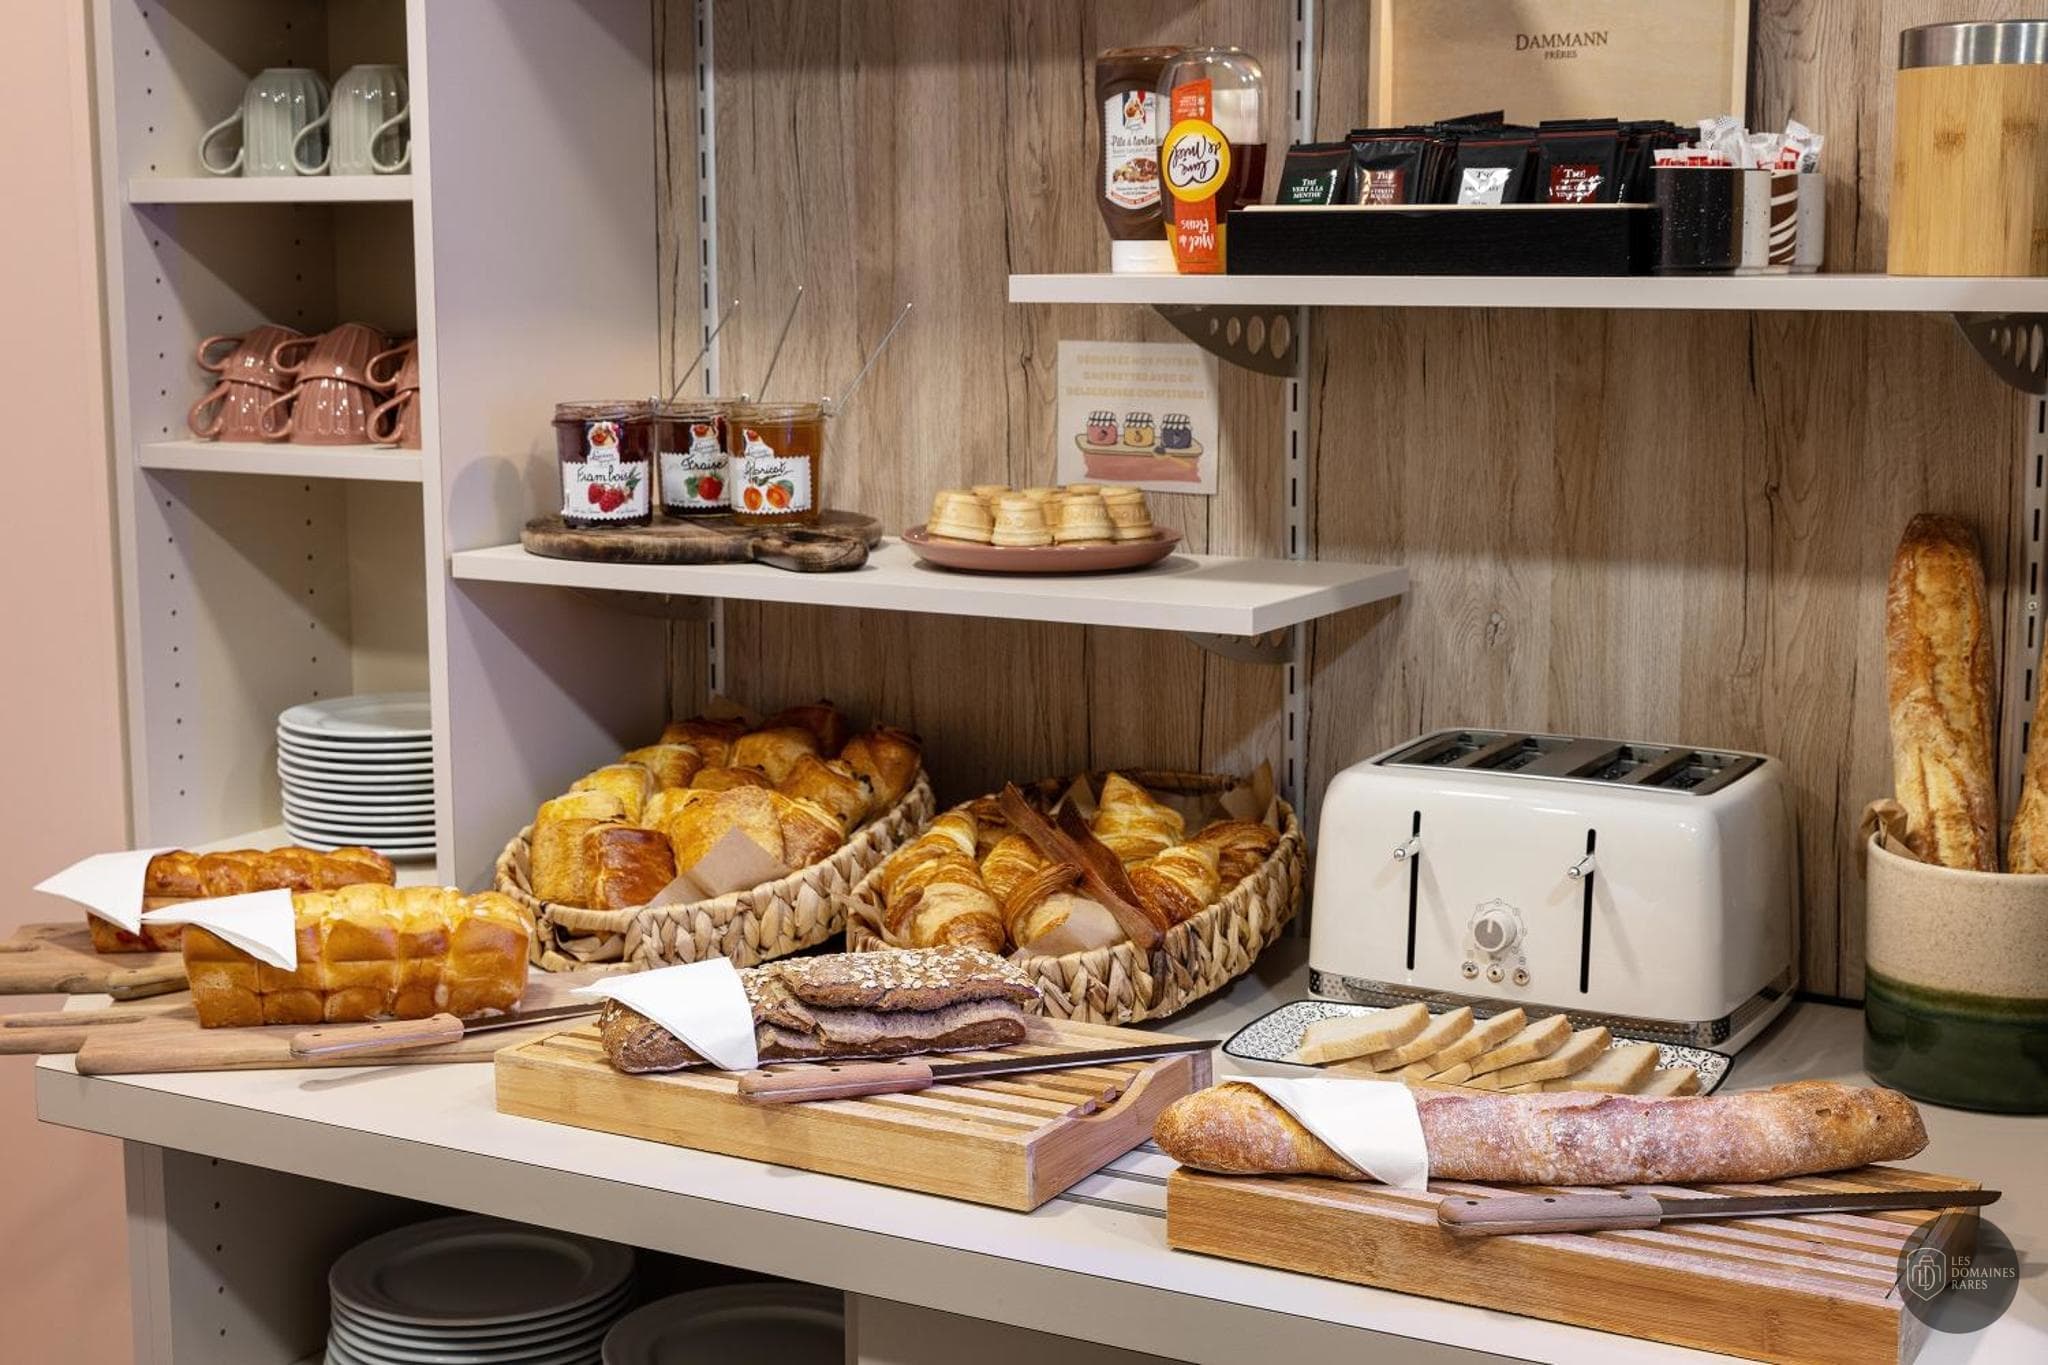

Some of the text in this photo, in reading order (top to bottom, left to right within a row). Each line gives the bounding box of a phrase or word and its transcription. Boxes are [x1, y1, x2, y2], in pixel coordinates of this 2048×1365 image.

[1516, 31, 1609, 51] DAMMANN
[1545, 49, 1578, 60] FRÈRES
[1188, 233, 1215, 253] Miel
